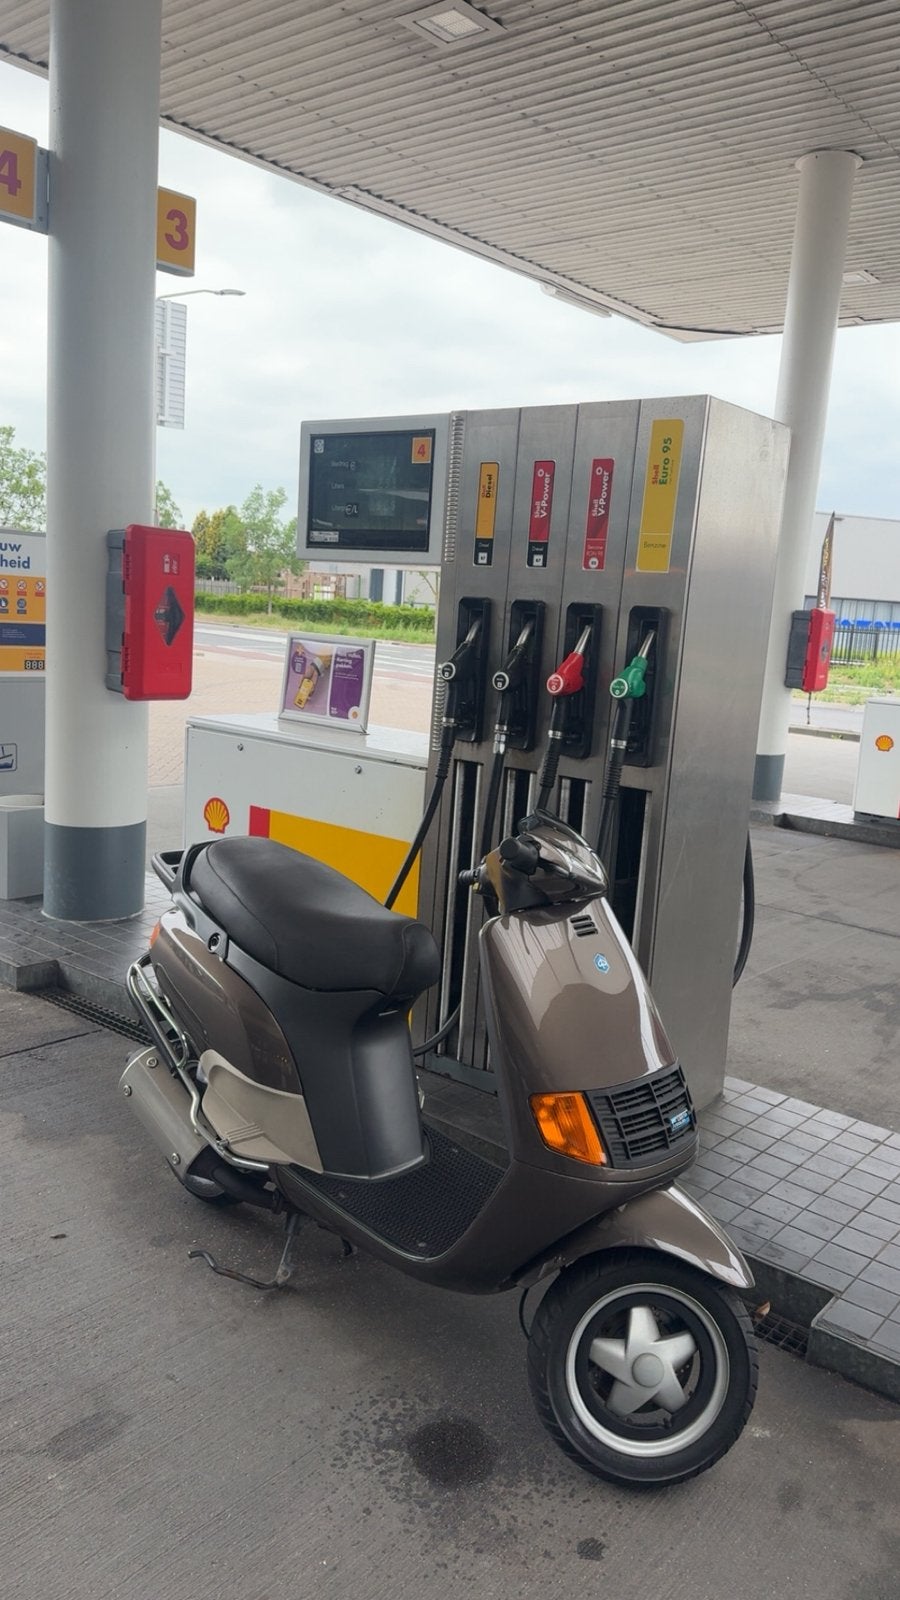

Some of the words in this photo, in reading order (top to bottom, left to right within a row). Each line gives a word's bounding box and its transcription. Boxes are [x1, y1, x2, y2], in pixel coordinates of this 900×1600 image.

[0, 149, 22, 197] 4
[164, 208, 190, 251] 3
[417, 444, 426, 457] 4
[663, 437, 672, 453] 95
[652, 464, 660, 485] Shell
[659, 458, 670, 485] Euro
[485, 474, 493, 498] Diesel
[540, 472, 551, 518] V-Power
[598, 470, 610, 517] V-Power
[643, 541, 667, 549] Benzine
